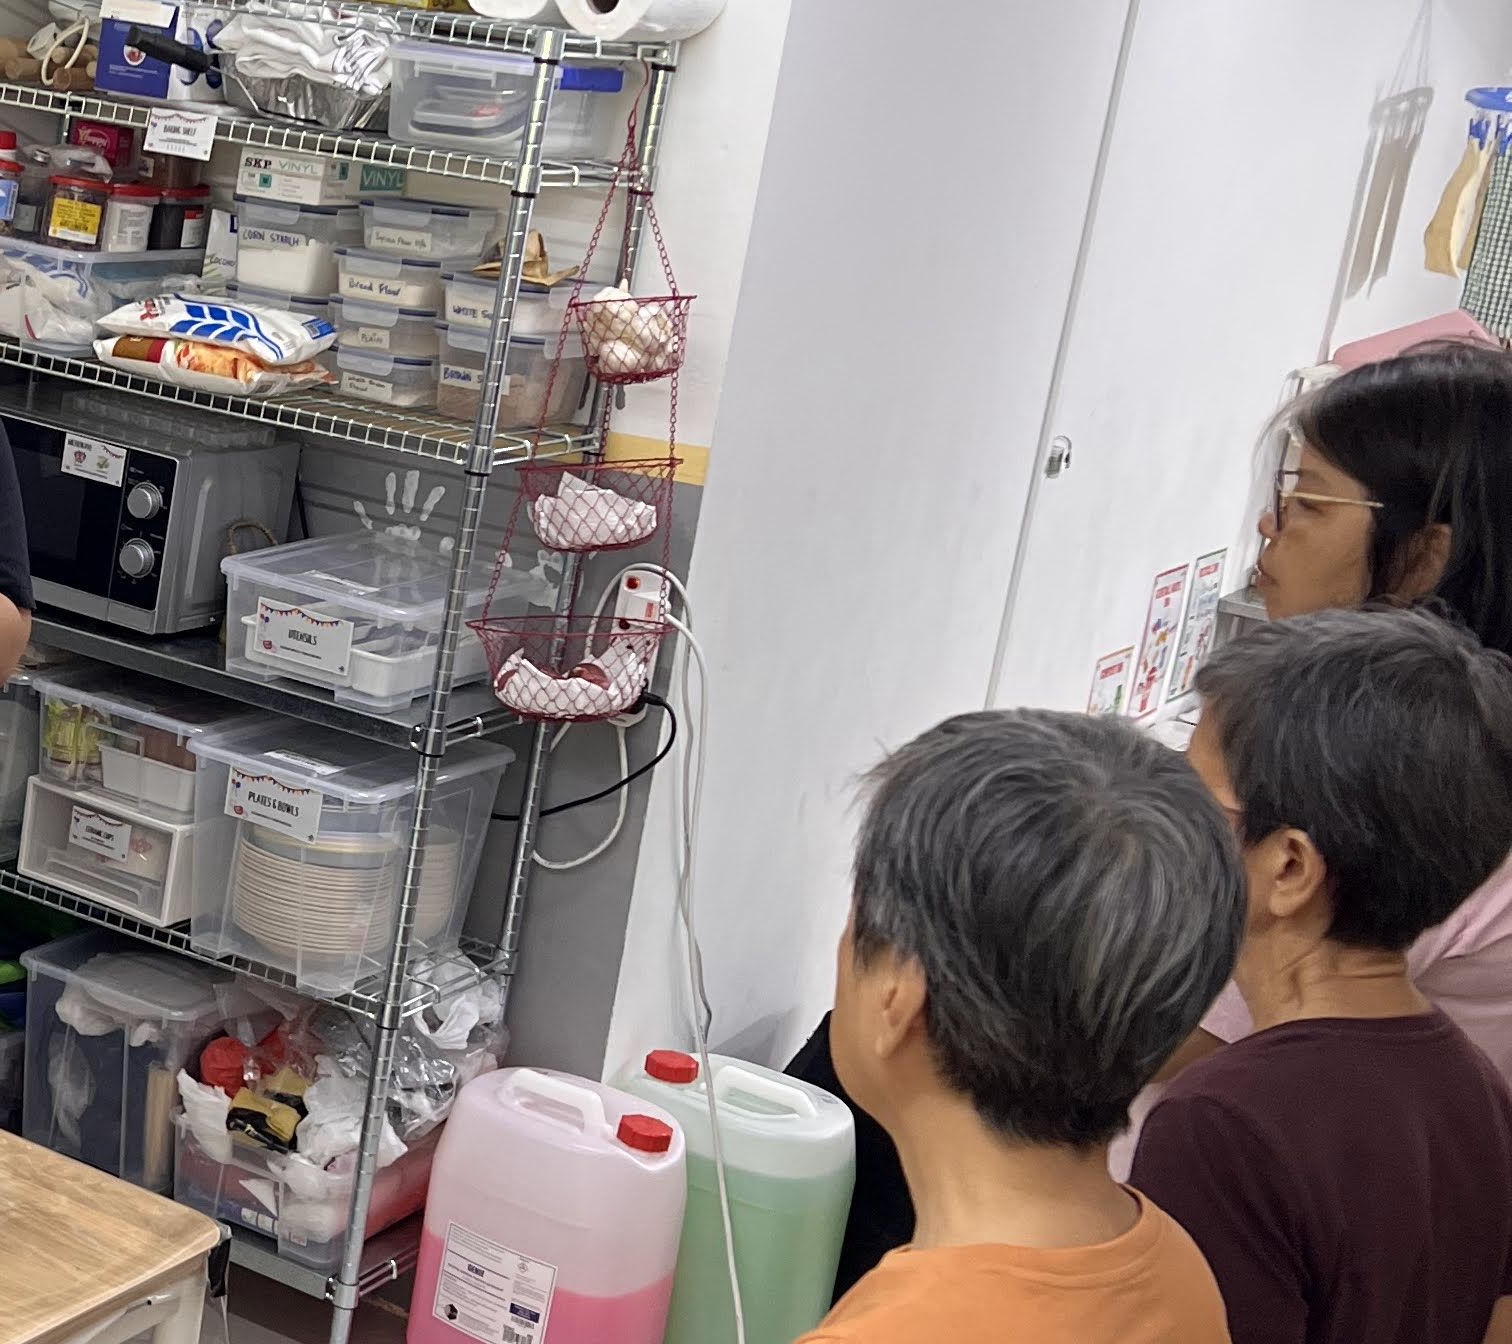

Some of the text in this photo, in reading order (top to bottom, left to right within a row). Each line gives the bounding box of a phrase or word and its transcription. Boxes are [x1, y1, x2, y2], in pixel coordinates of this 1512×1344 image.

[244, 156, 319, 175] SKP VINYL
[362, 168, 405, 188] VINYL
[348, 276, 374, 292] Bread
[288, 629, 317, 646] UTENSILS
[248, 790, 272, 808] PLATES
[277, 800, 300, 817] BOWLS
